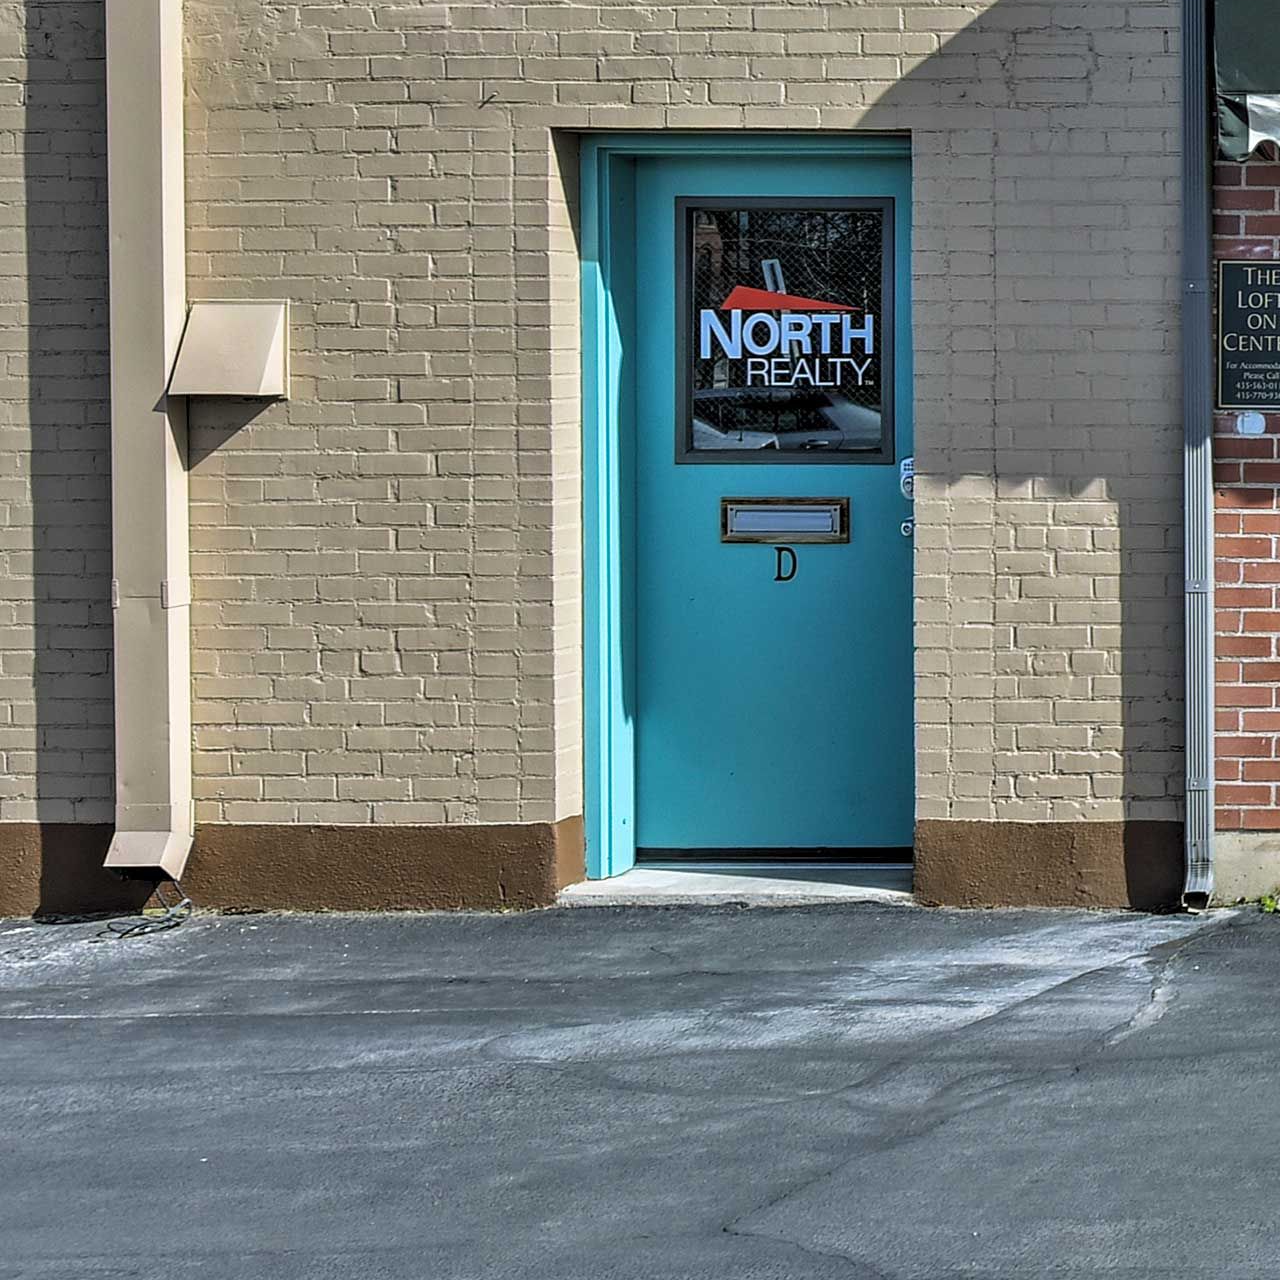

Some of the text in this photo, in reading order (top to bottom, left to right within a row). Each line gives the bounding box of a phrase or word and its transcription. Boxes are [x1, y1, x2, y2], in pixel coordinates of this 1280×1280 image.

[700, 309, 874, 360] NORTH
[1247, 313, 1277, 330] ON
[746, 358, 872, 386] REALTY
[773, 546, 798, 582] D
